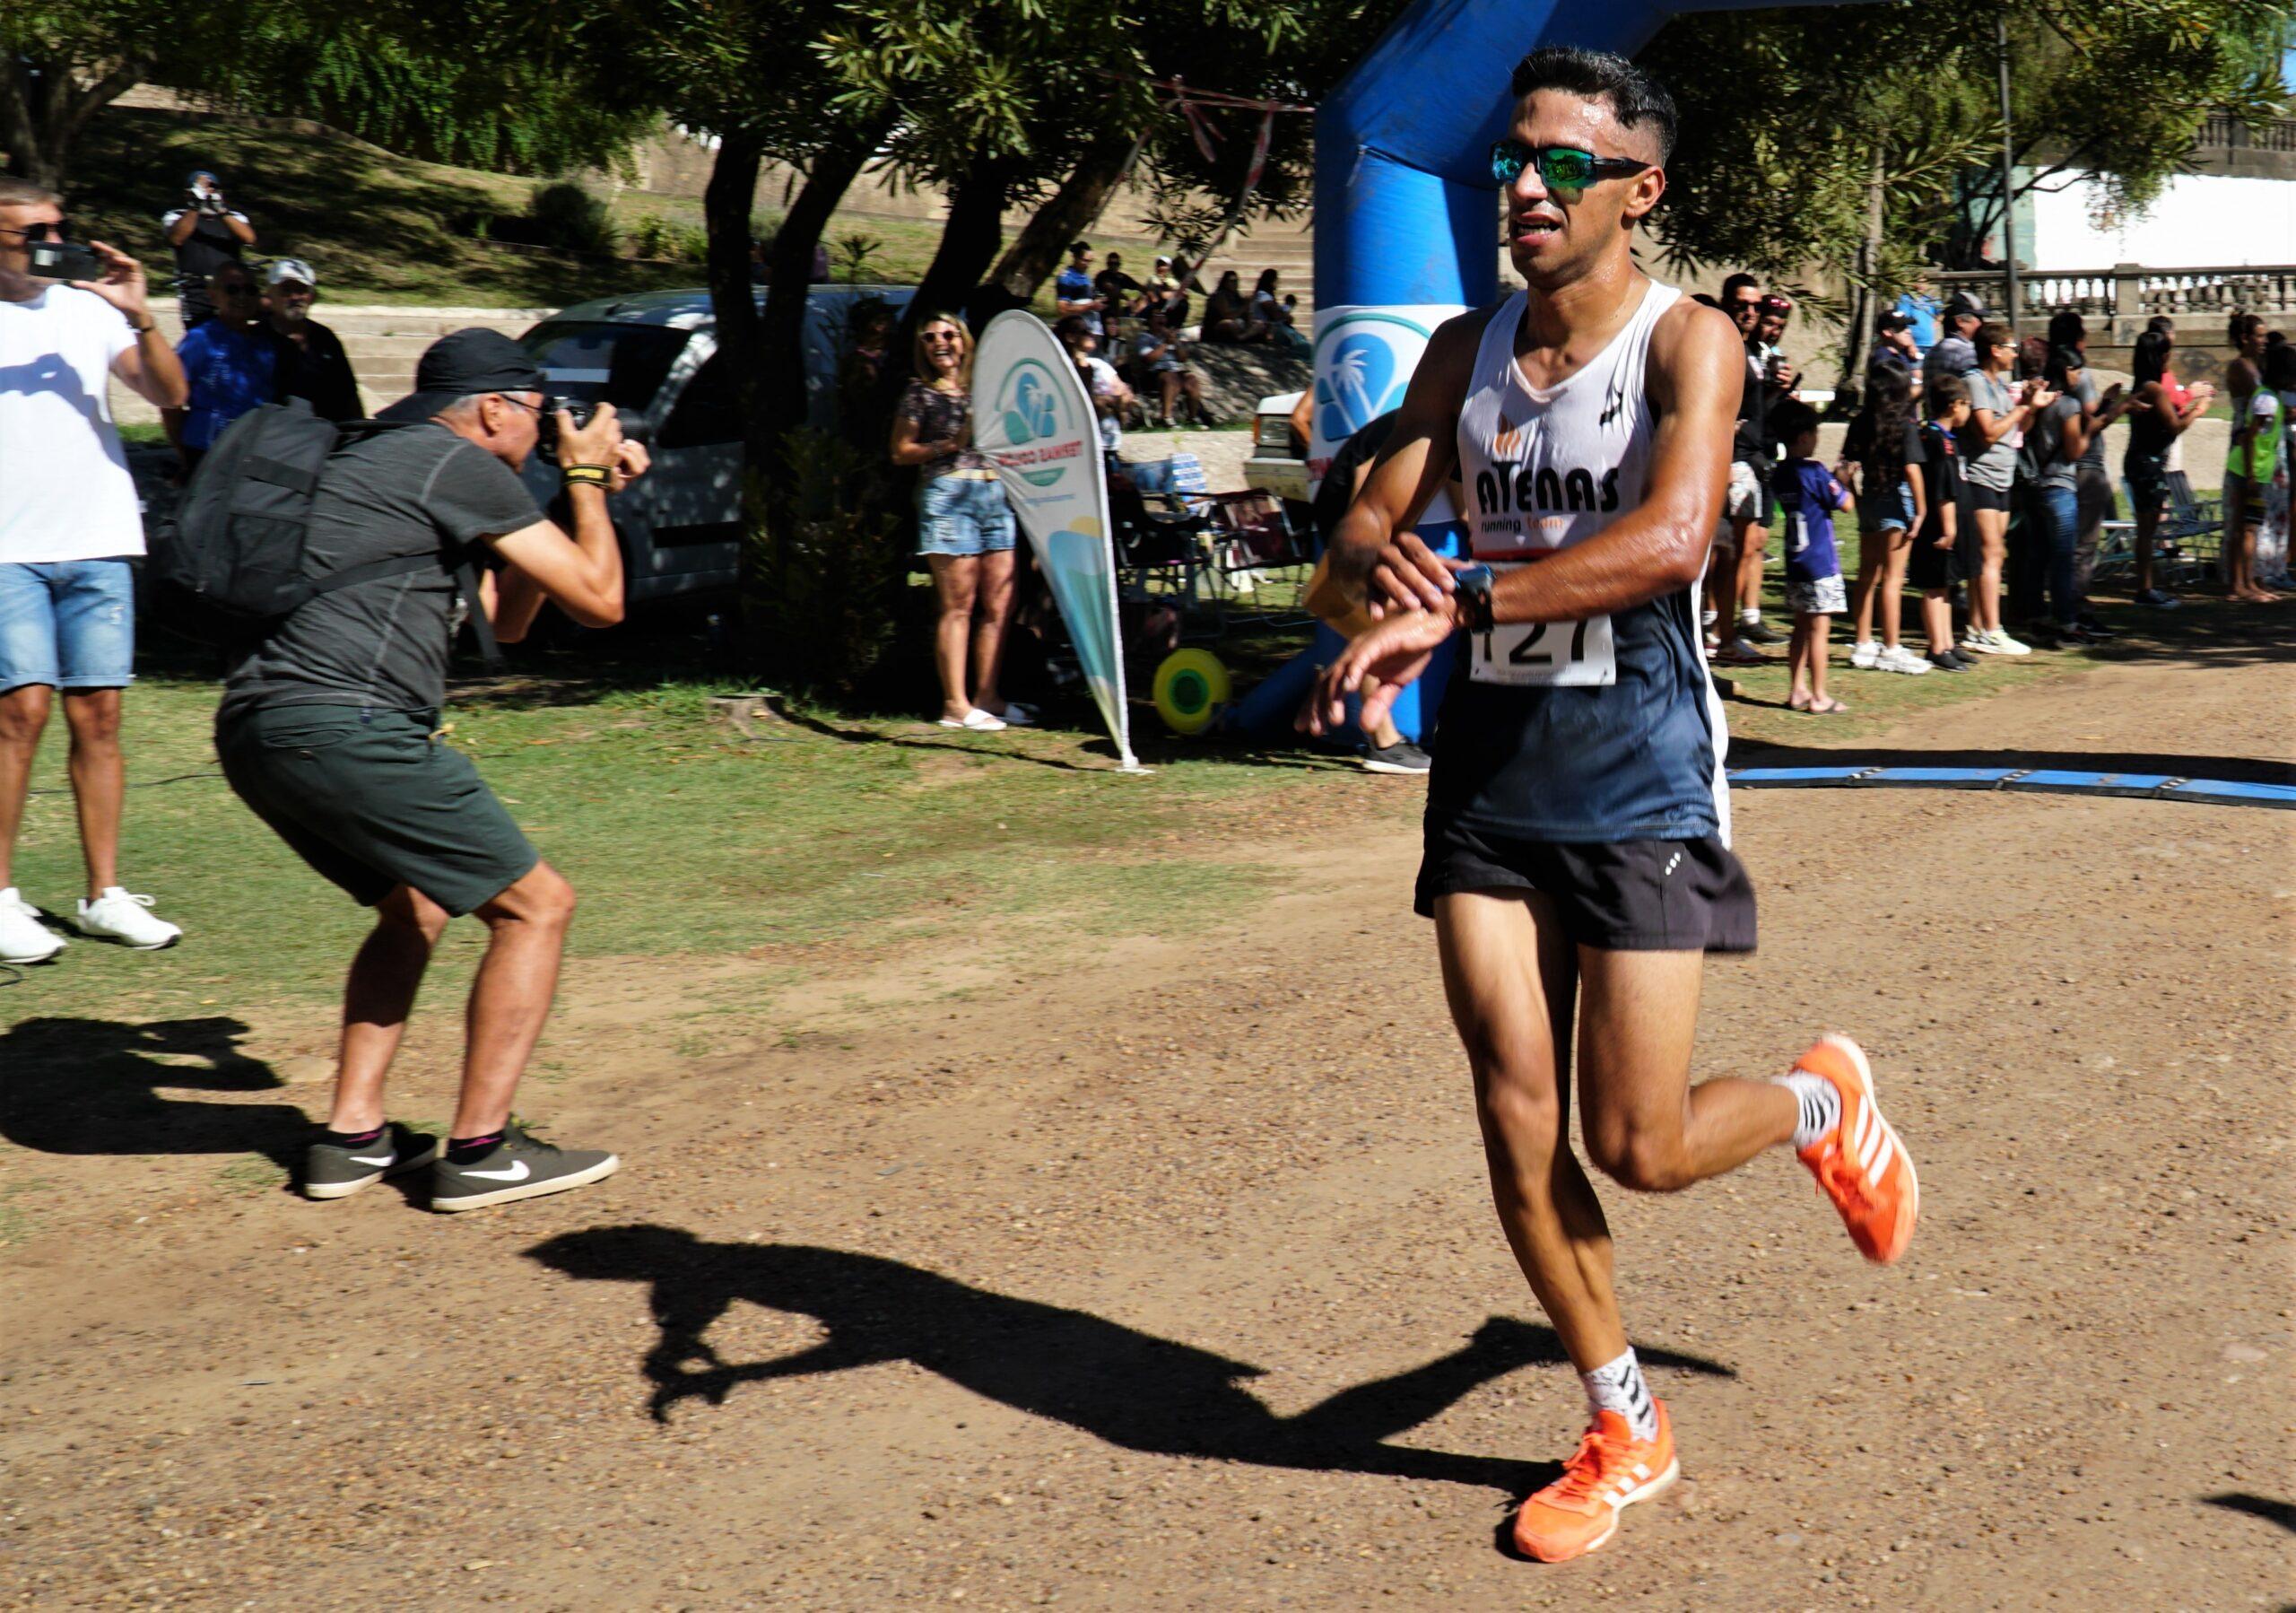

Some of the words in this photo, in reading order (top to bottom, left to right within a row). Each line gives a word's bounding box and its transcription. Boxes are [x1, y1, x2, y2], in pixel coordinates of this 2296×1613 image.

[1476, 460, 1619, 513] ATENAS
[1481, 518, 1521, 533] running
[1527, 516, 1564, 531] team
